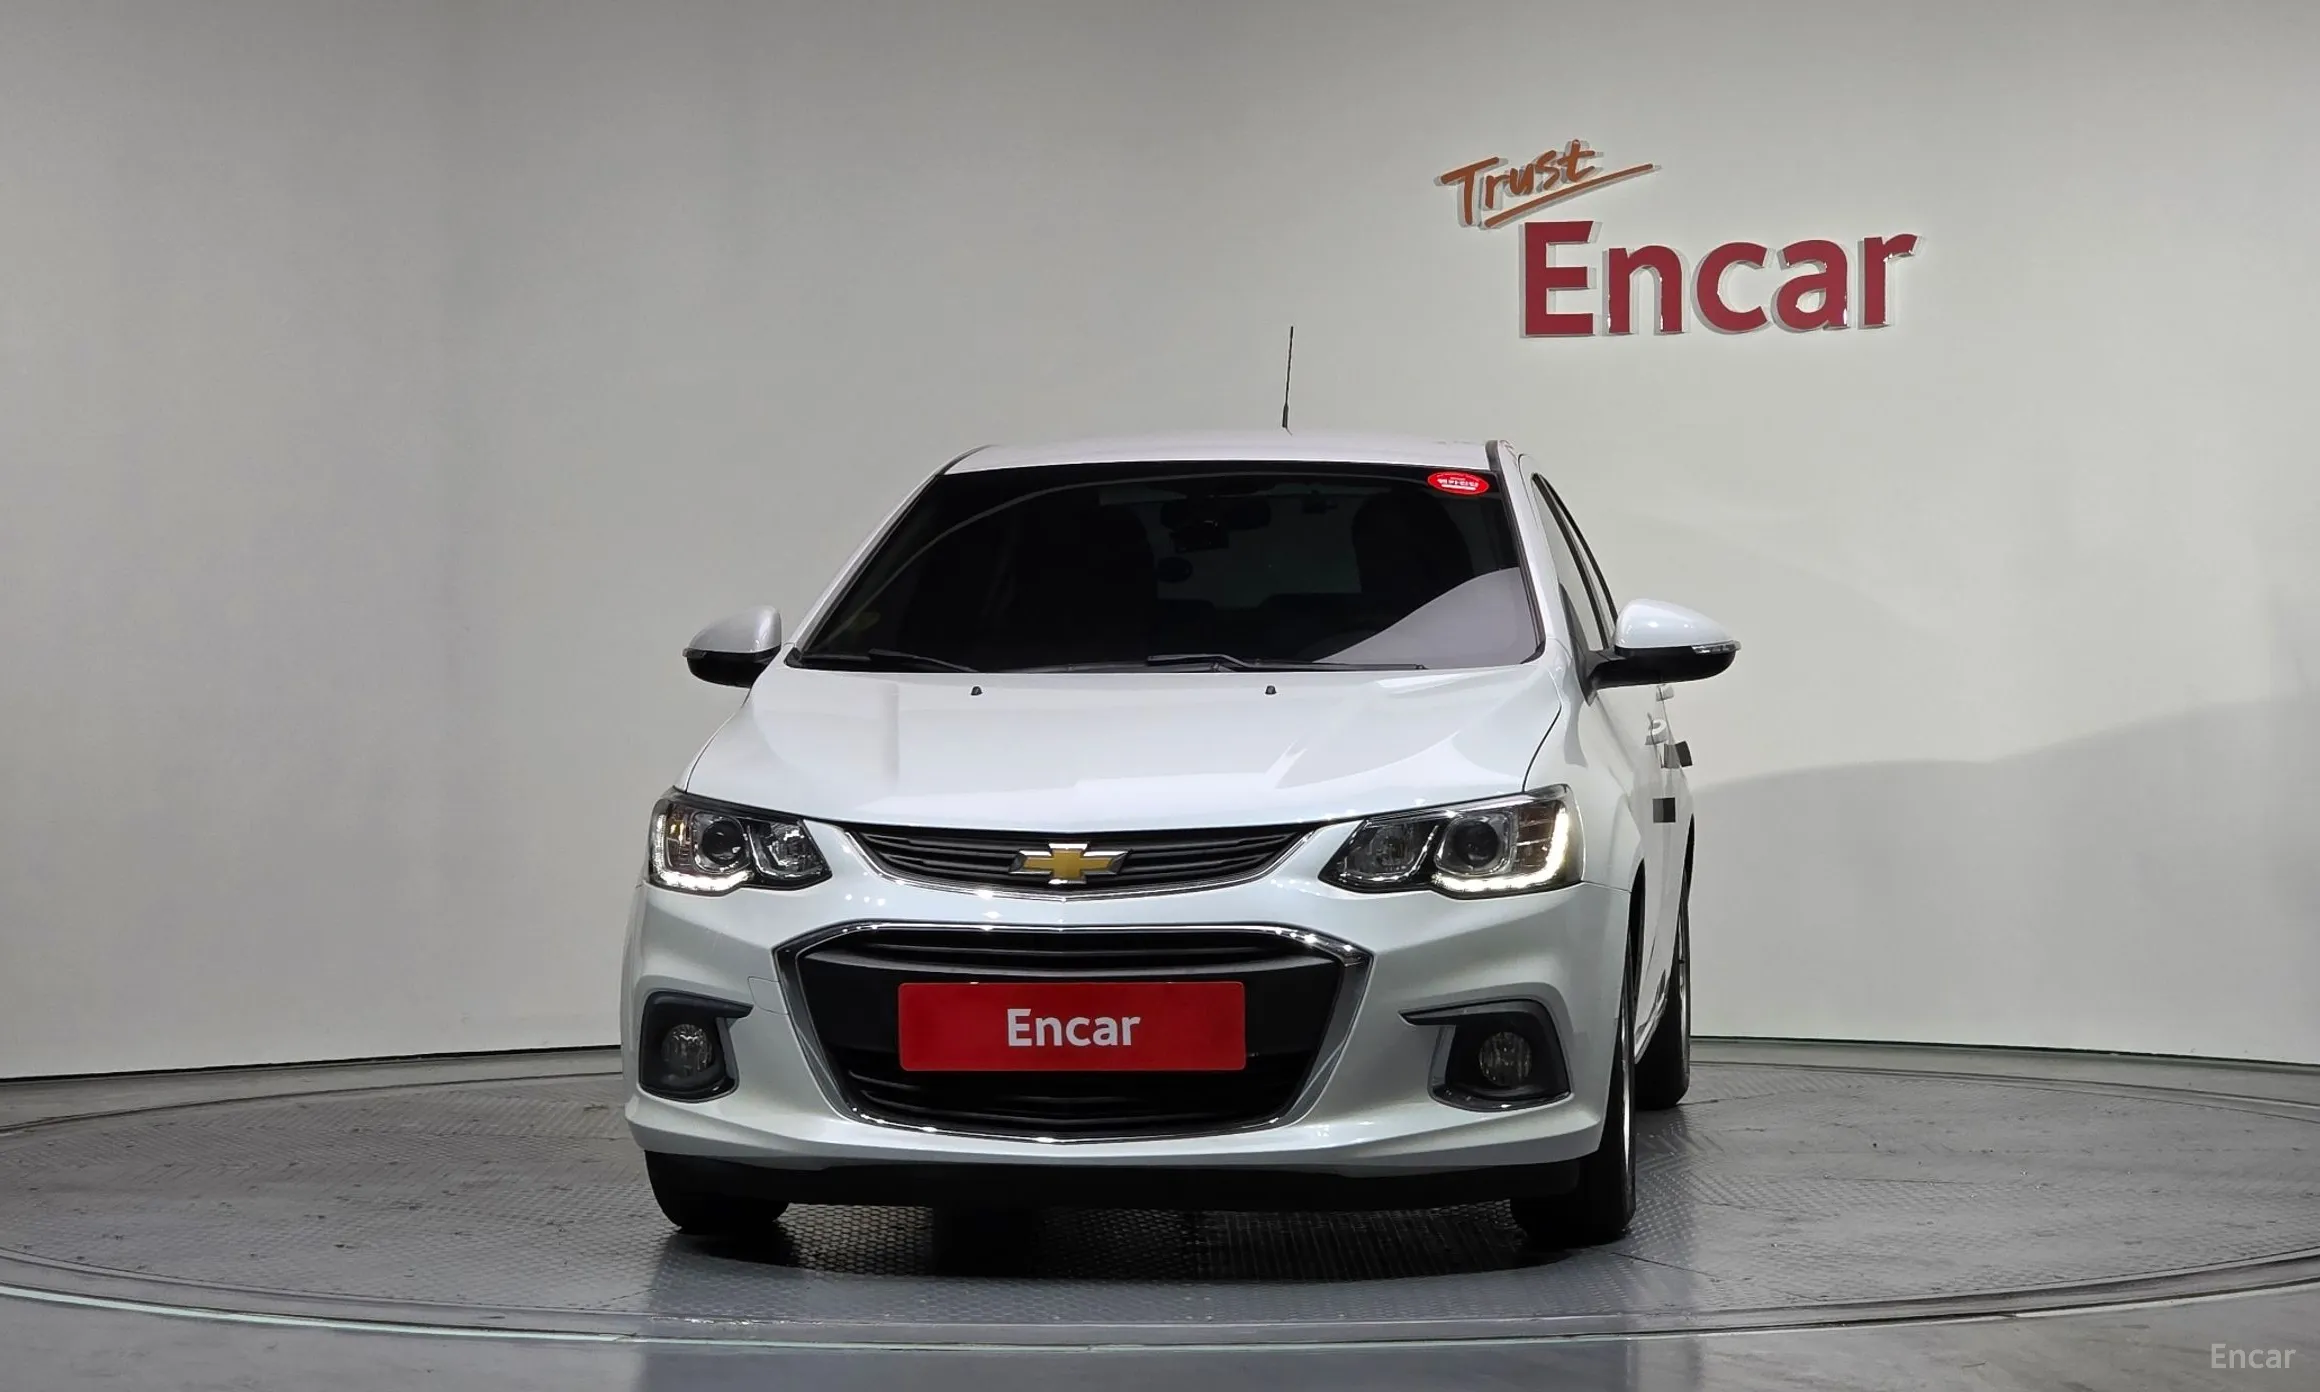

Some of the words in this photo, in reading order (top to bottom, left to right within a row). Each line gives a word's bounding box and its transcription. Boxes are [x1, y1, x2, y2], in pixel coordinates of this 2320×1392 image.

[1441, 139, 1597, 225] Trust
[1524, 220, 1918, 335] Encar
[1007, 1008, 1141, 1047] Encar
